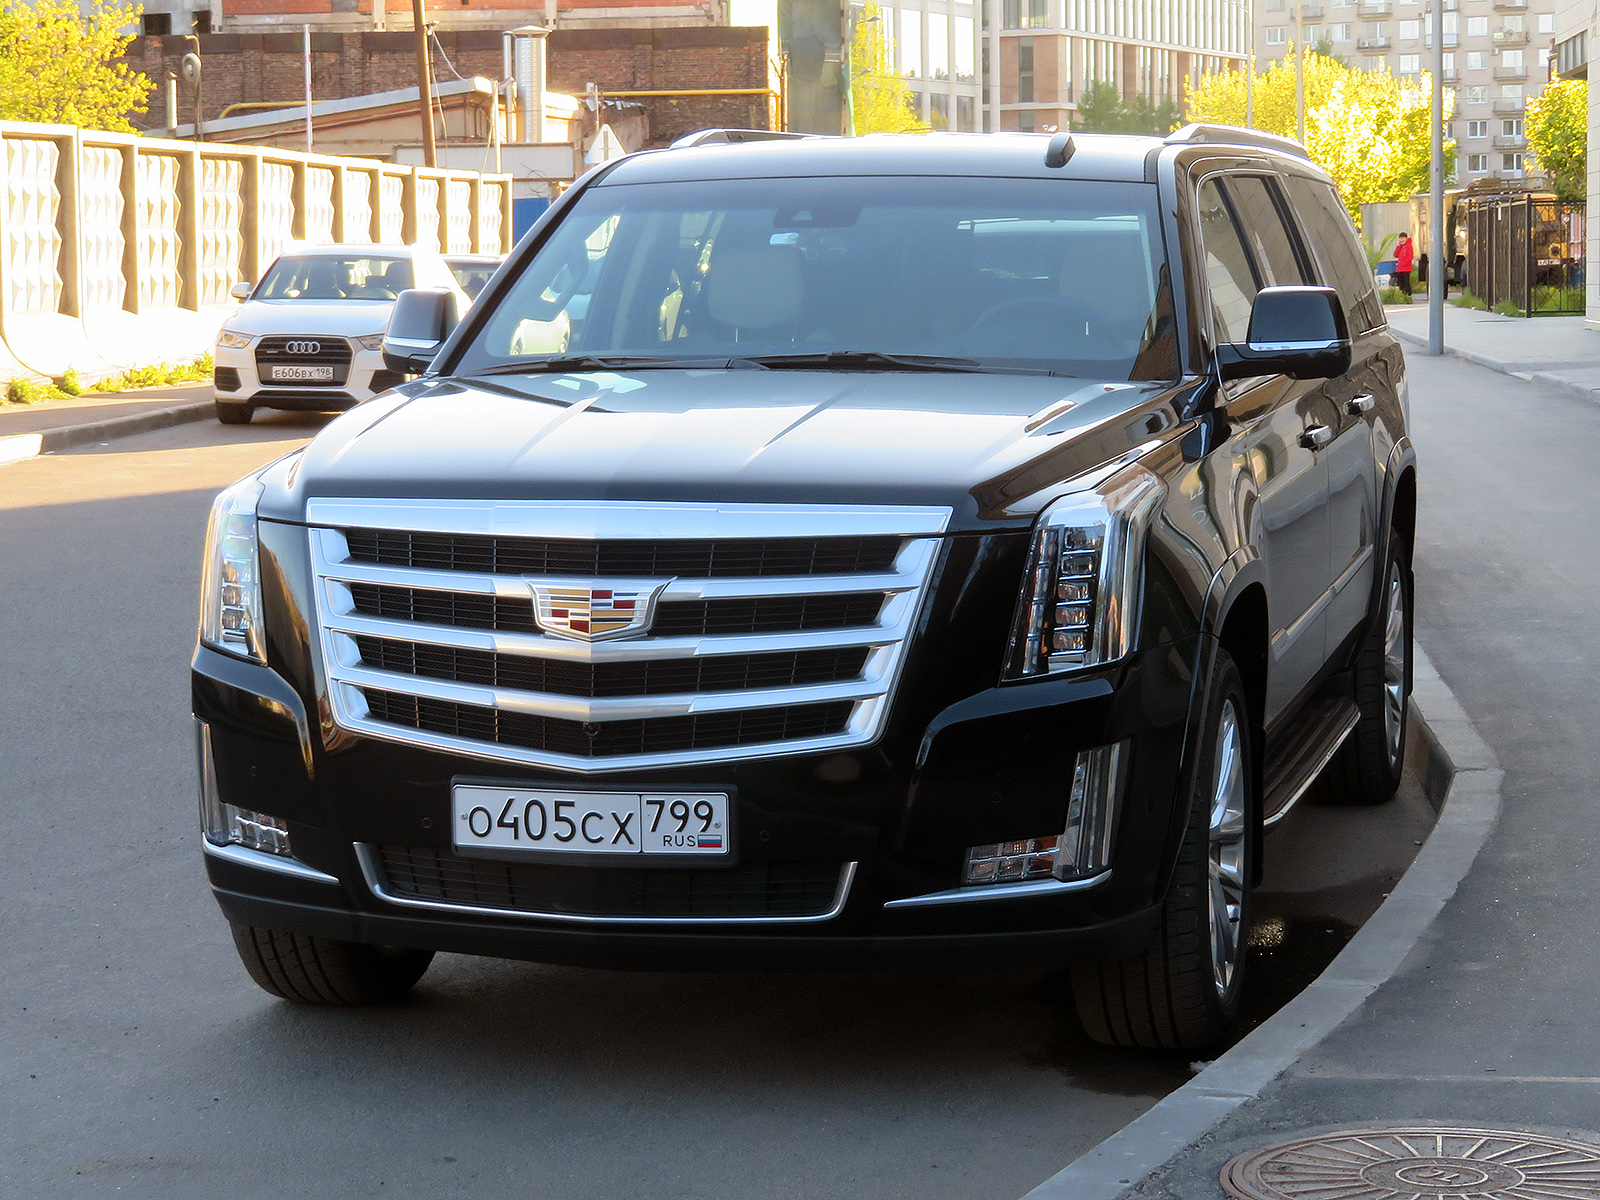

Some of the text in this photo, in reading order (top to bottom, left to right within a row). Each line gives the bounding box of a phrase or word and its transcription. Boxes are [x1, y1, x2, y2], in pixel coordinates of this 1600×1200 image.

[315, 367, 331, 376] 198
[645, 799, 714, 833] 799
[663, 835, 696, 848] RUS
